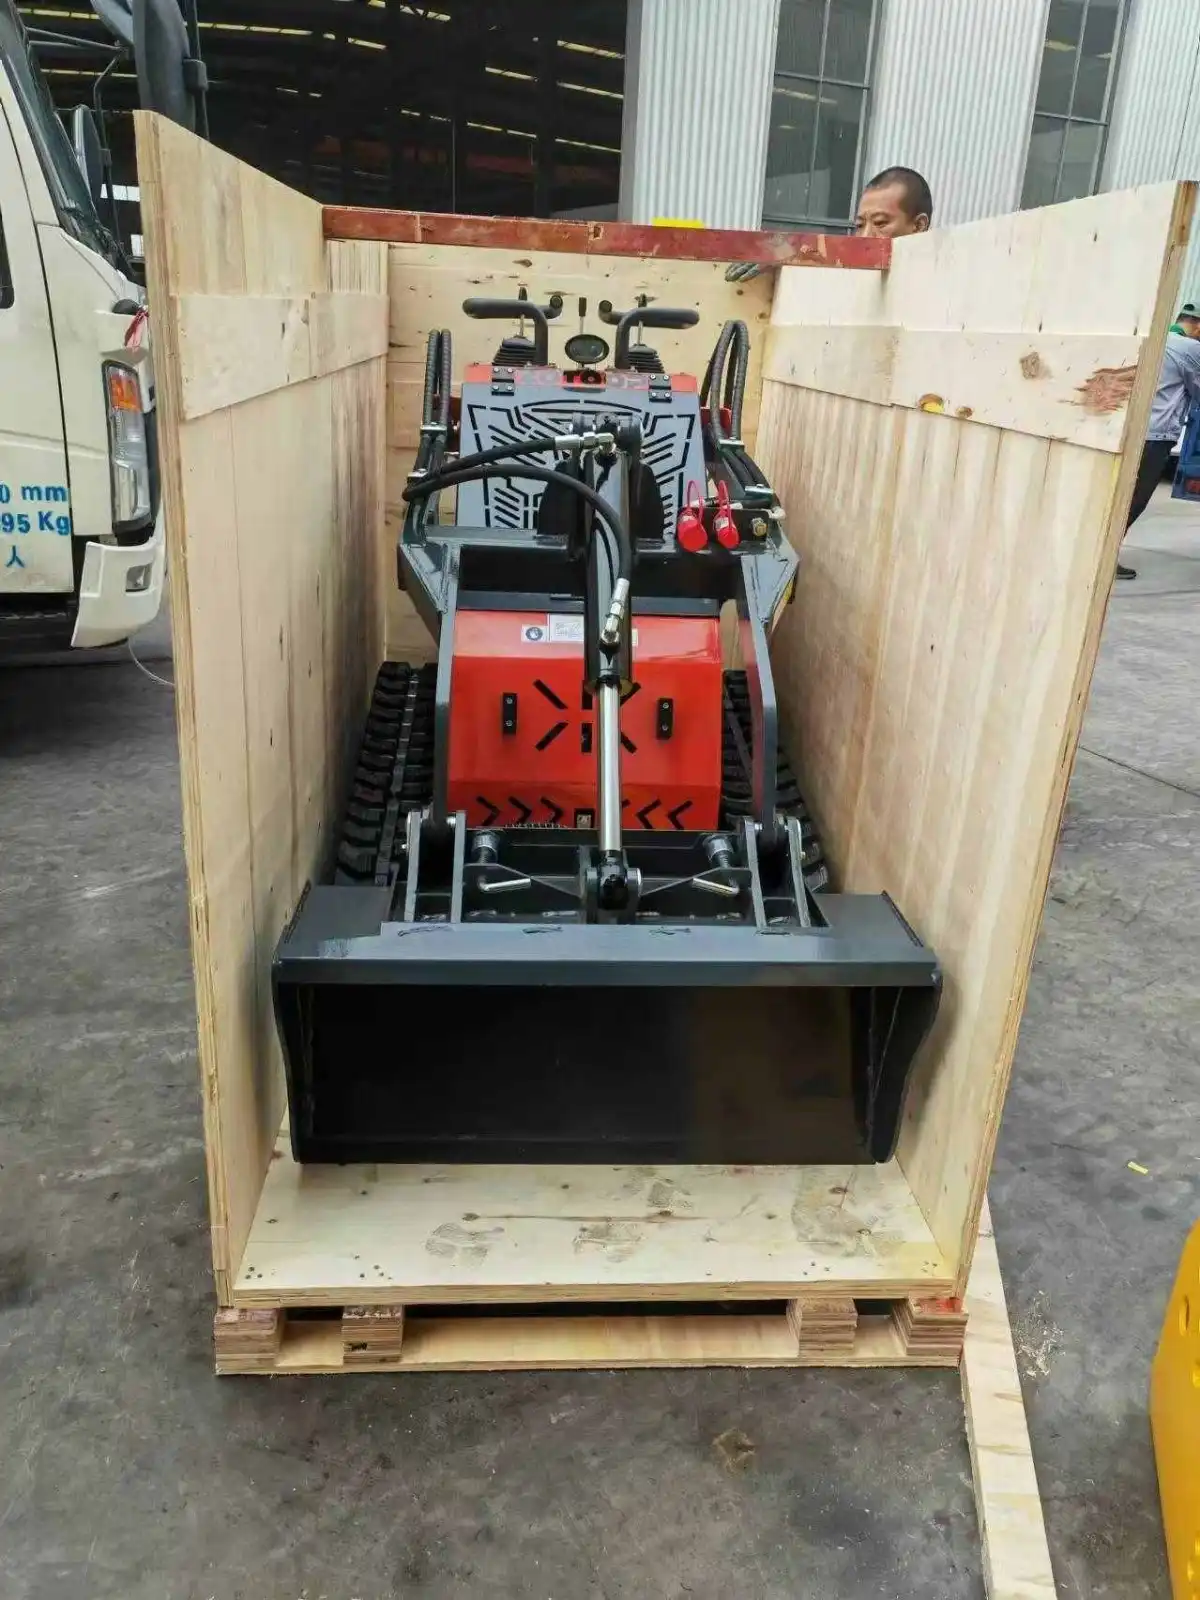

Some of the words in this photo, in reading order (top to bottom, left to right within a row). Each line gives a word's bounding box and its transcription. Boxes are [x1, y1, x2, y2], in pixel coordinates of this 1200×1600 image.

[21, 486, 67, 501] mm
[1, 512, 30, 533] 95
[38, 511, 70, 535] Kg
[5, 545, 25, 567] 人
